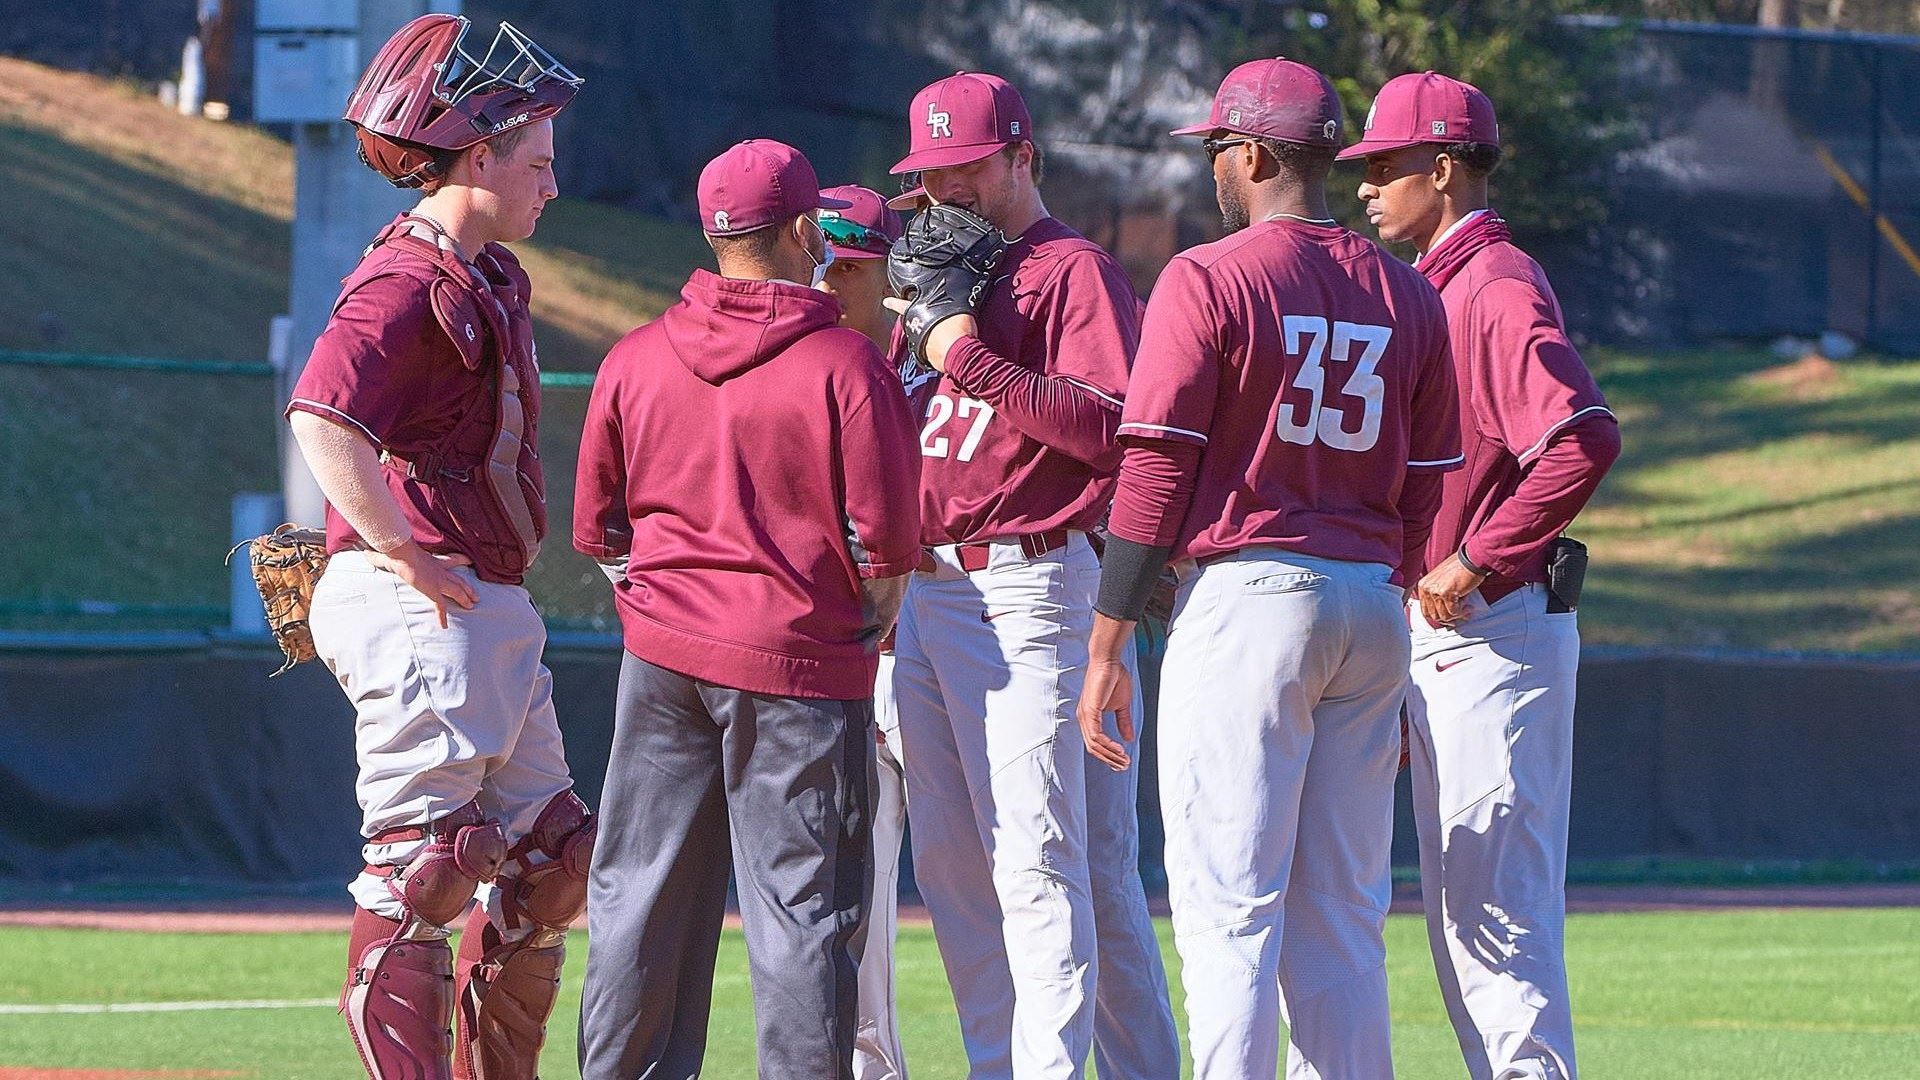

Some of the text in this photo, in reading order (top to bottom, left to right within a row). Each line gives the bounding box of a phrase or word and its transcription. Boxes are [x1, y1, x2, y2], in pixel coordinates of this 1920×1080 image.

[491, 112, 529, 134] ALL-STAR
[926, 102, 952, 138] LR
[1277, 315, 1393, 453] 33
[920, 394, 995, 462] 27
